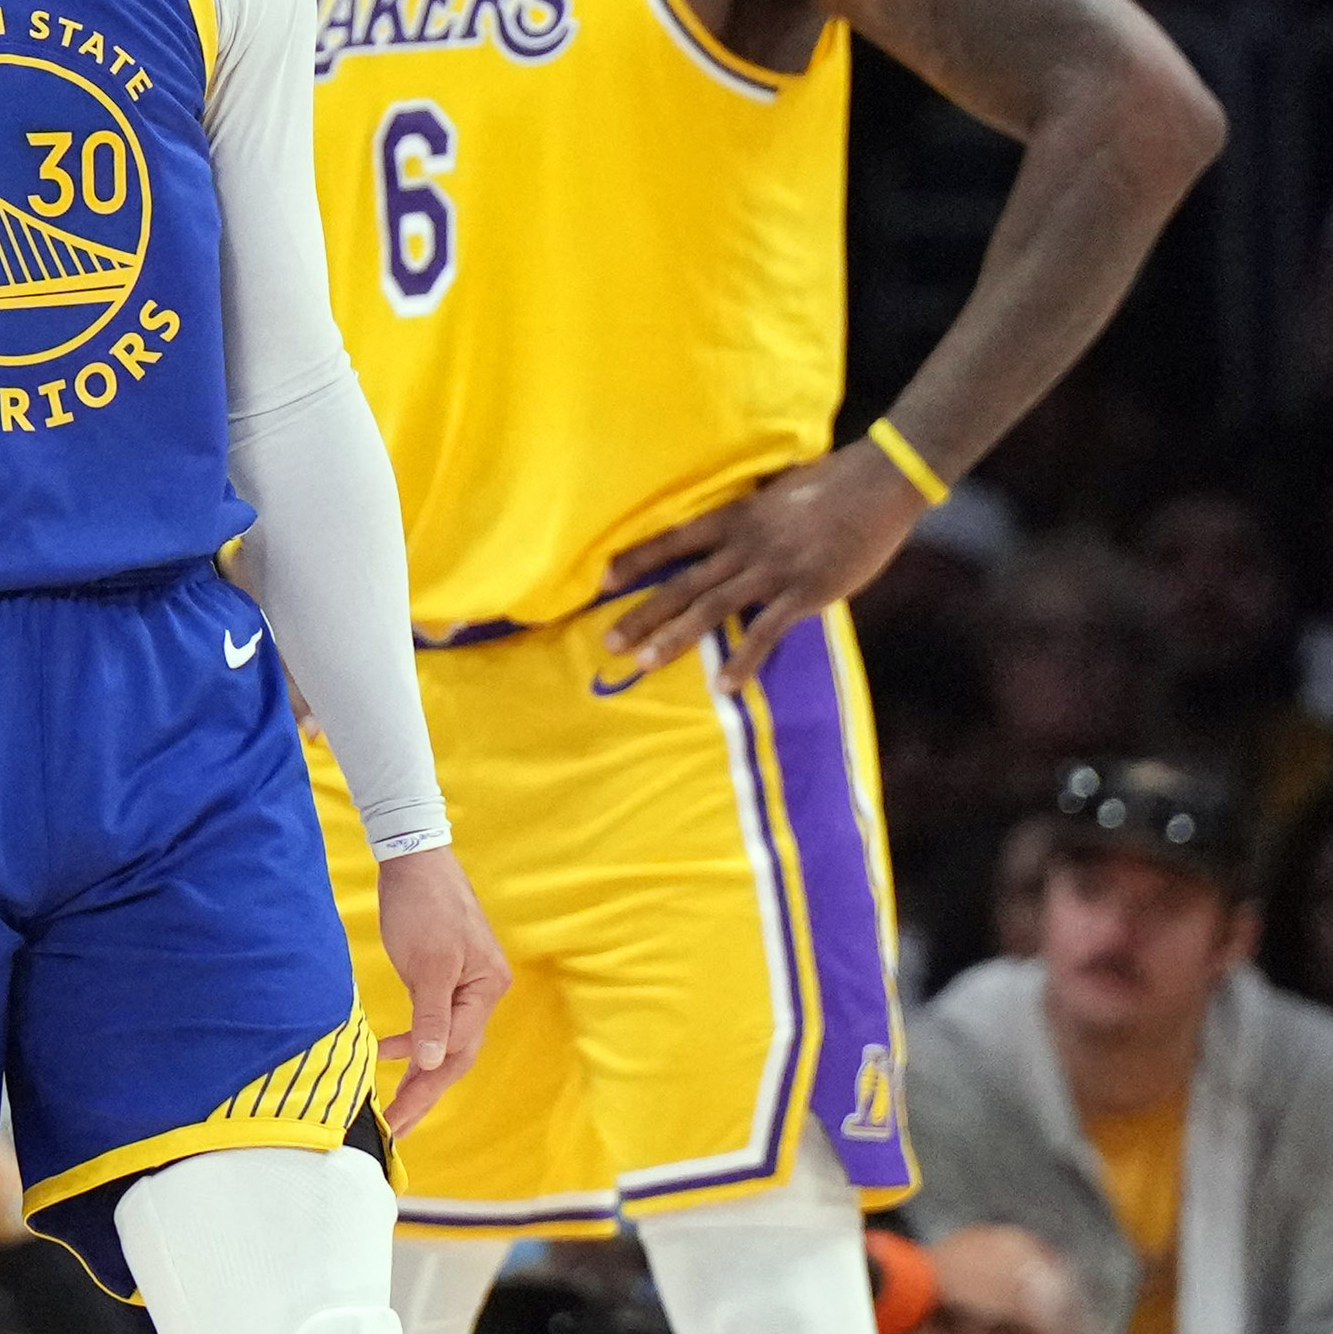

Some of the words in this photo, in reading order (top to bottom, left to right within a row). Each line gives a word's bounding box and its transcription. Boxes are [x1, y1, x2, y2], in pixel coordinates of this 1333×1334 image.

[29, 10, 154, 102] STATE
[26, 130, 128, 217] 30
[377, 103, 457, 315] 6
